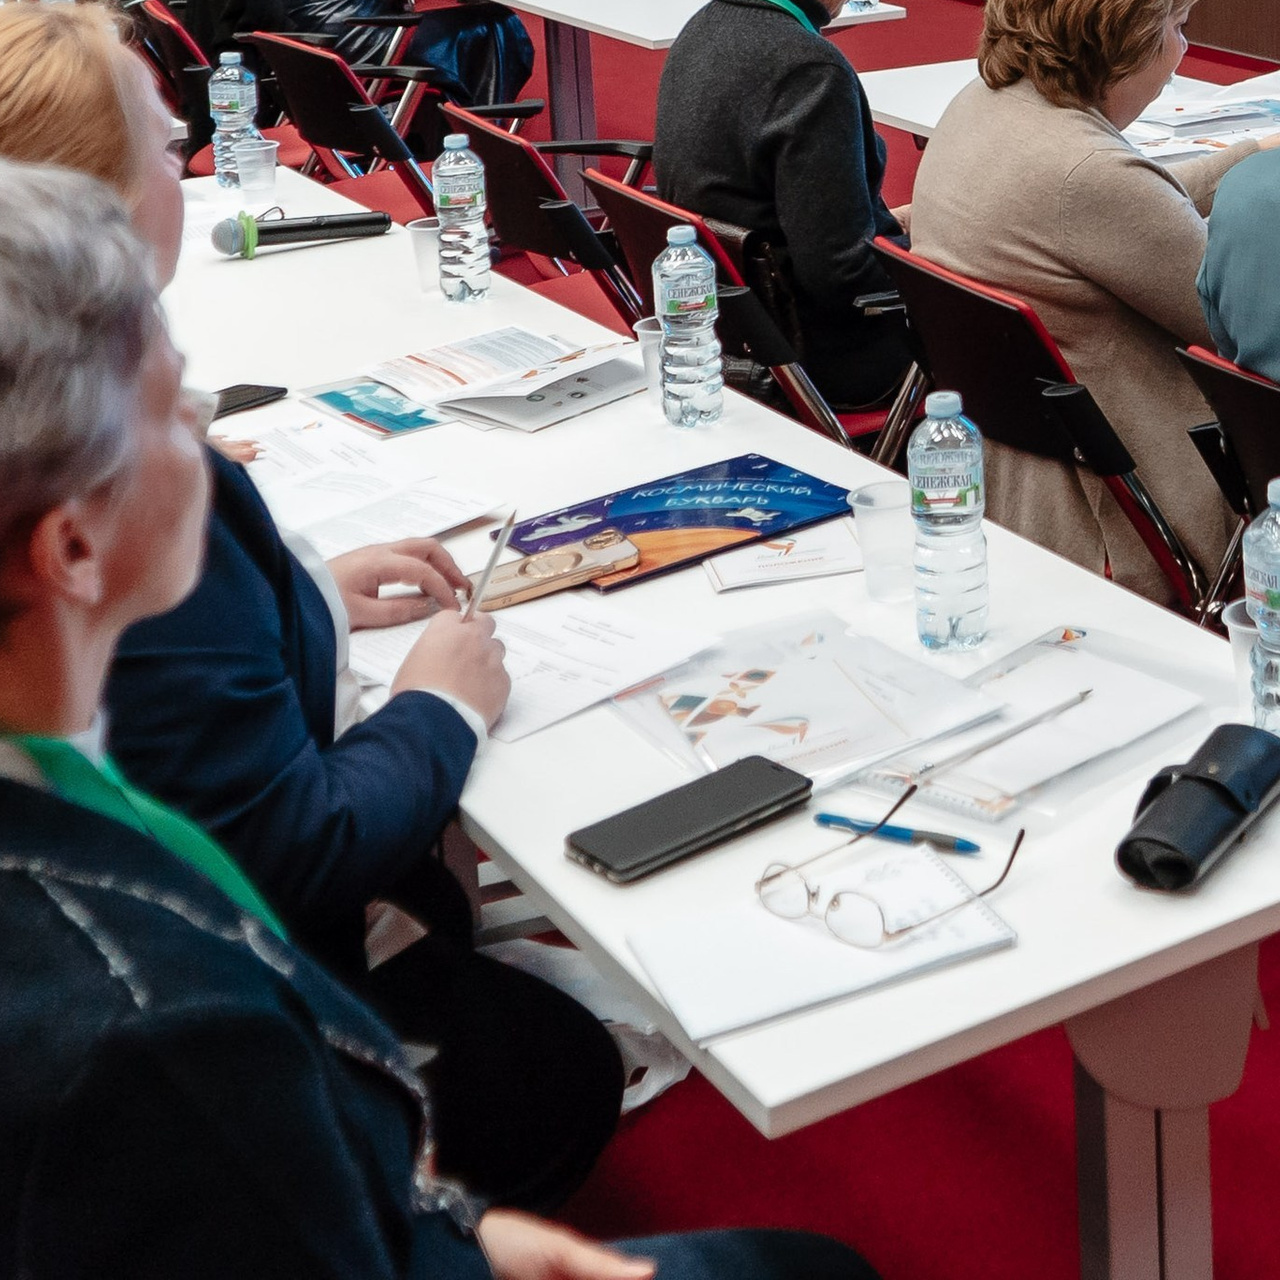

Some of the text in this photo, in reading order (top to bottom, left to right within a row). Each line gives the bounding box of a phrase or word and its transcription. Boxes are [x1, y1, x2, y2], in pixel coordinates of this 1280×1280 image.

[912, 474, 972, 489] СЕНЕЖСКАЯ
[632, 482, 812, 500] КОСМИЧЕСКИЙ
[665, 495, 770, 507] БУКВАРЬ
